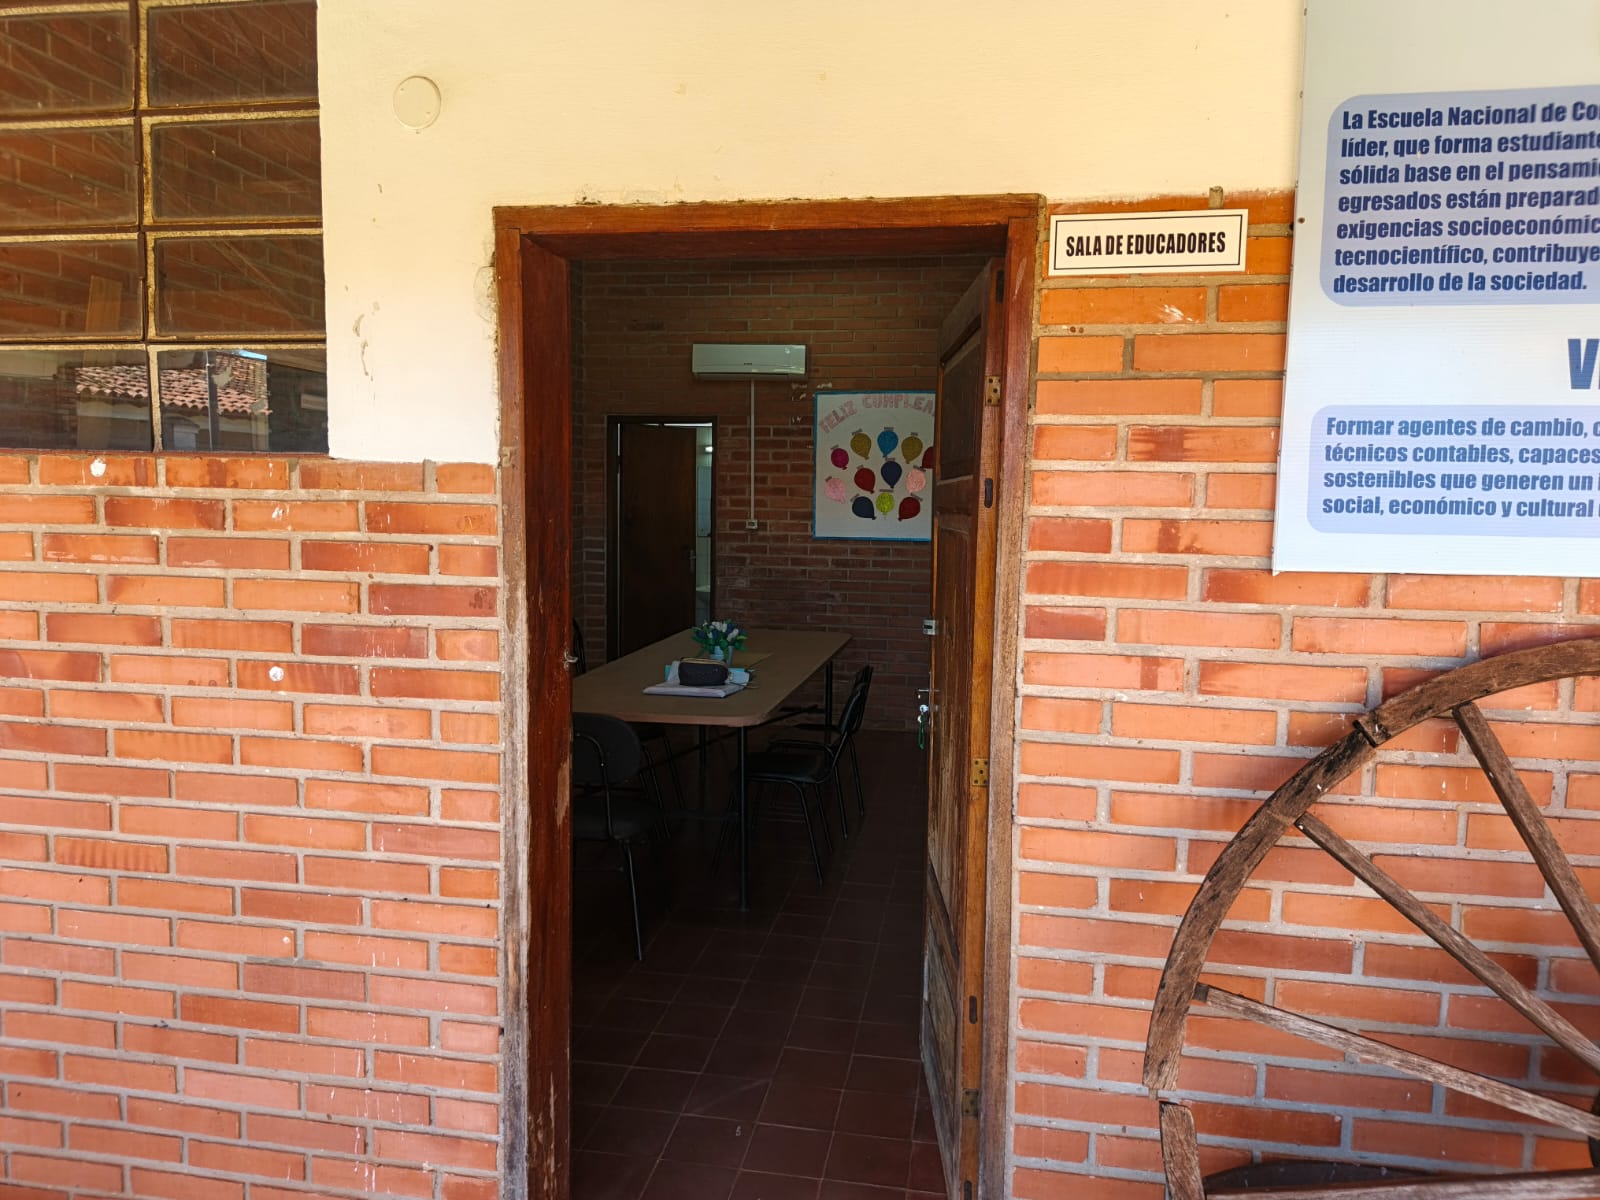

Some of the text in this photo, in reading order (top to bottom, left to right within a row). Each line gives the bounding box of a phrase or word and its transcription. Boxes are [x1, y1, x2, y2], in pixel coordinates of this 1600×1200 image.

[1342, 101, 1600, 130] La Escuela Nacional de Co
[1341, 138, 1390, 158] líder,
[1393, 138, 1430, 158] que
[1434, 135, 1492, 155] forma
[1339, 157, 1600, 185] sólida base en el pensami
[1338, 191, 1442, 214] egresados
[1446, 188, 1501, 209] están
[1336, 218, 1443, 240] exigencias
[1066, 231, 1226, 257] SALA DE EDUCADORES
[1334, 244, 1488, 266] tecnocientífico,
[1333, 271, 1587, 293] desarrollo de la sociedad.
[1568, 338, 1600, 390] V
[862, 393, 936, 417] CUMPLEA
[1326, 417, 1395, 437] Formar
[1397, 418, 1477, 438] agentes
[1481, 418, 1506, 436] de
[1510, 418, 1588, 439] cambio,
[1325, 443, 1408, 463] técnicos
[1412, 444, 1514, 465] contables,
[1323, 470, 1436, 489] sostenibles
[1440, 473, 1477, 491] que
[1481, 474, 1564, 491] generen
[1568, 474, 1593, 491] un
[1322, 496, 1384, 516] social,
[1388, 496, 1497, 516] económico
[1500, 500, 1512, 518] y
[1516, 498, 1594, 518] cultural
